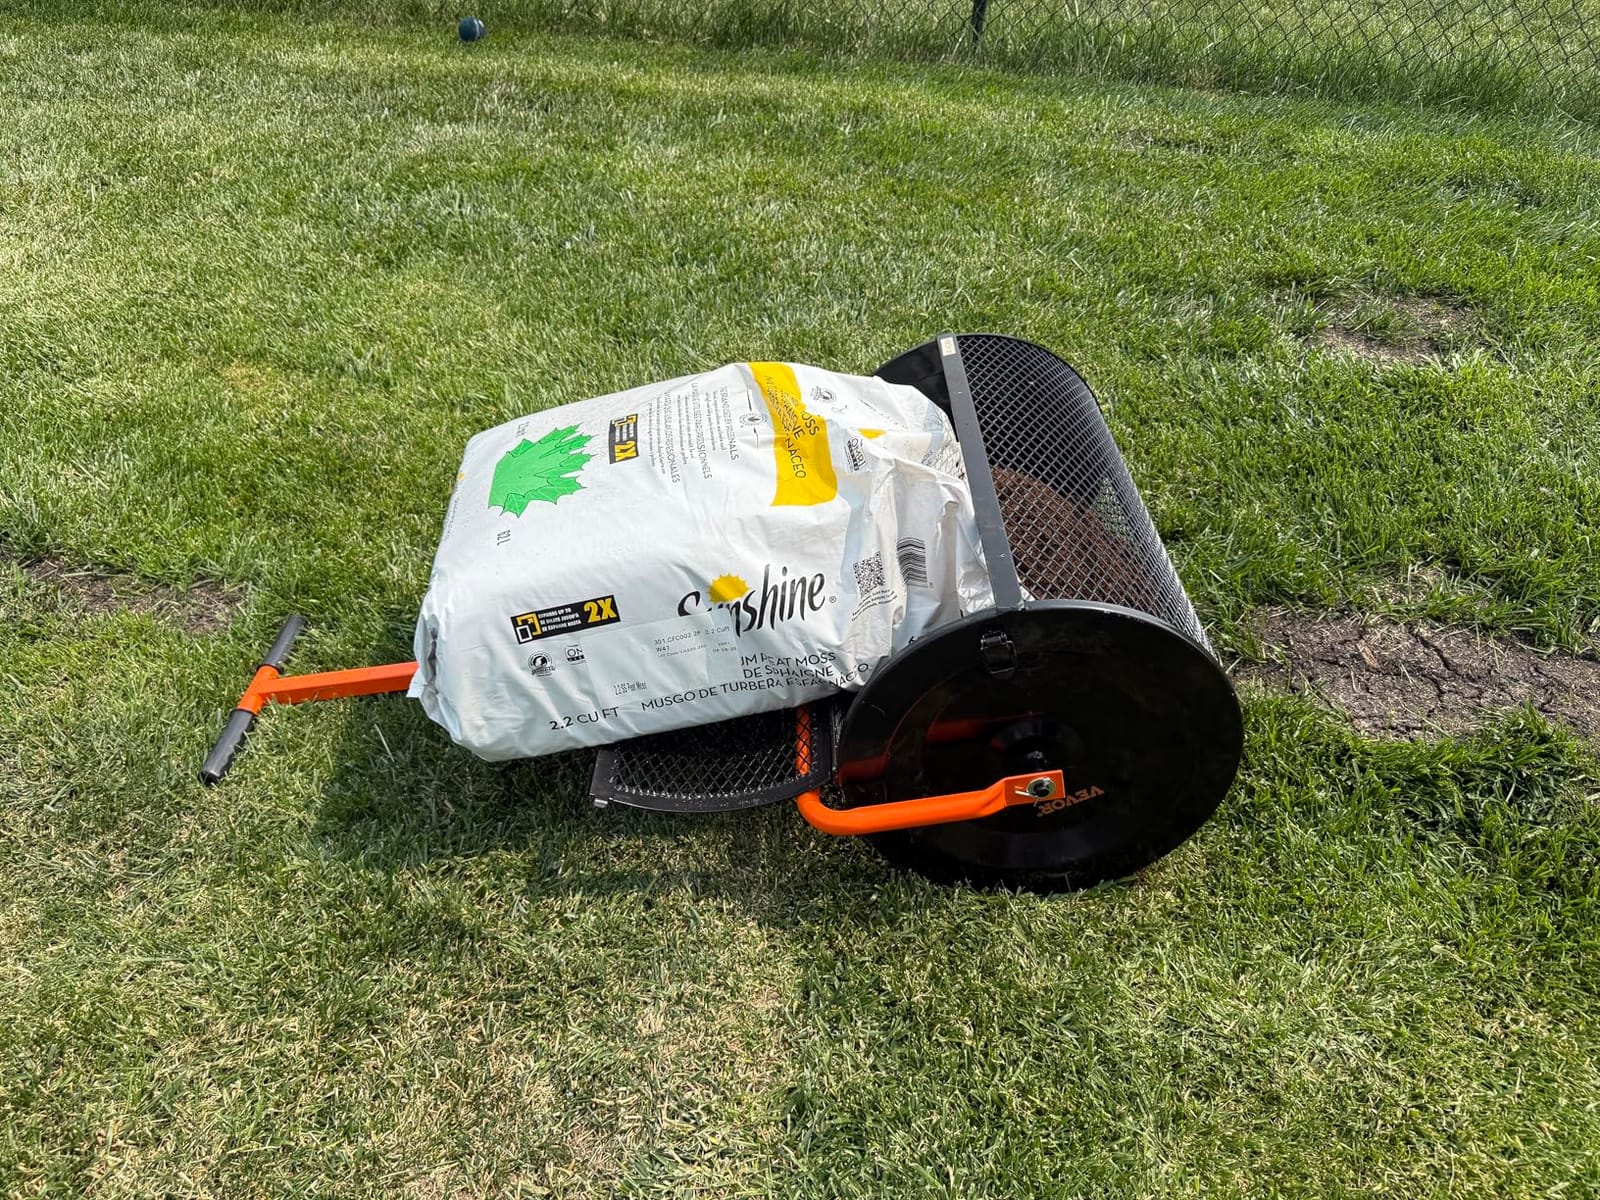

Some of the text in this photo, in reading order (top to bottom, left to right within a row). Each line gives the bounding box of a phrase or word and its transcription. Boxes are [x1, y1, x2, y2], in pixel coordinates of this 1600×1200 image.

[614, 440, 637, 462] 2X
[584, 597, 617, 623] 2X
[795, 651, 836, 668] MOSS
[743, 667, 762, 680] DE
[641, 690, 696, 711] MUSGO
[698, 686, 719, 699] DE
[720, 677, 784, 693] TURBERA
[549, 706, 620, 731] 2.2 CU FT
[1041, 785, 1105, 815] VEVOR
